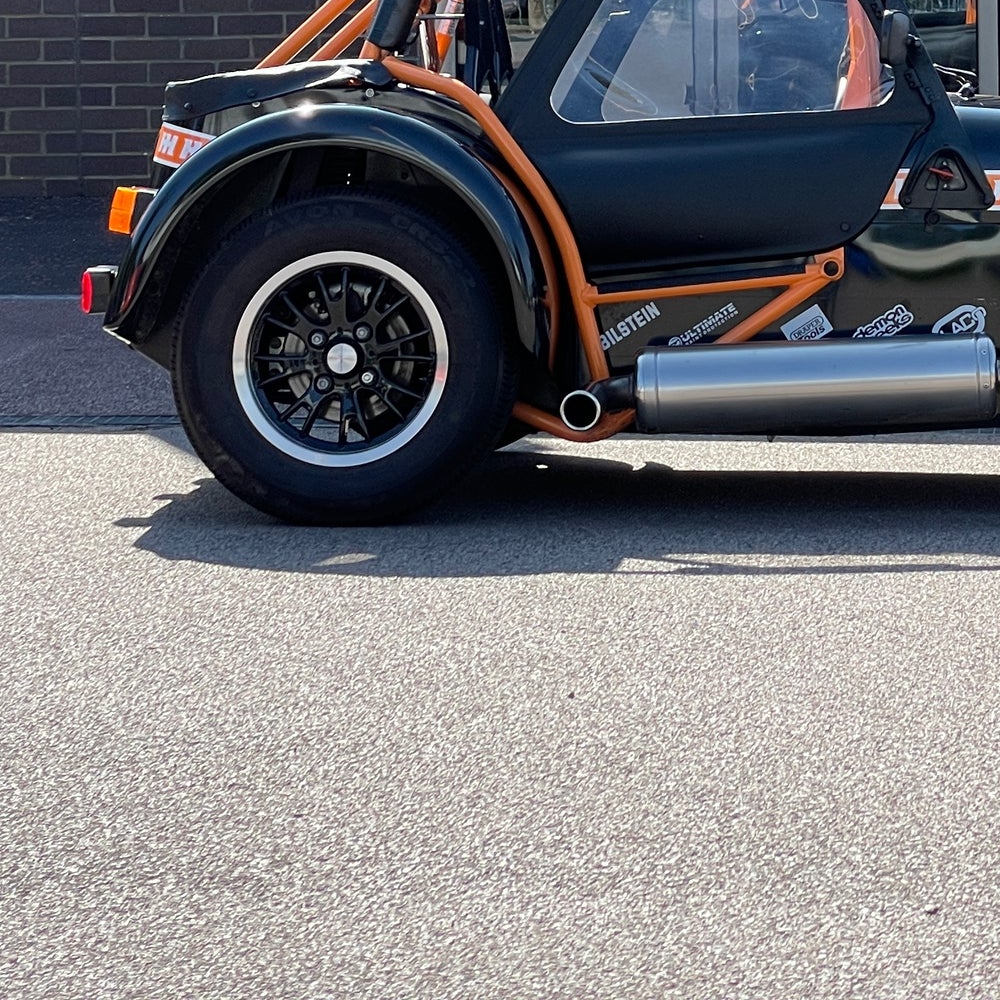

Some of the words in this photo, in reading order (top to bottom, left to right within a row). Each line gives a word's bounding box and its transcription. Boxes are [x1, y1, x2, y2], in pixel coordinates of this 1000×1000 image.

[600, 301, 661, 351] BILSTEIN
[680, 302, 737, 342] ULTIMATE
[792, 319, 821, 340] DRAPER
[939, 312, 977, 334] AC
